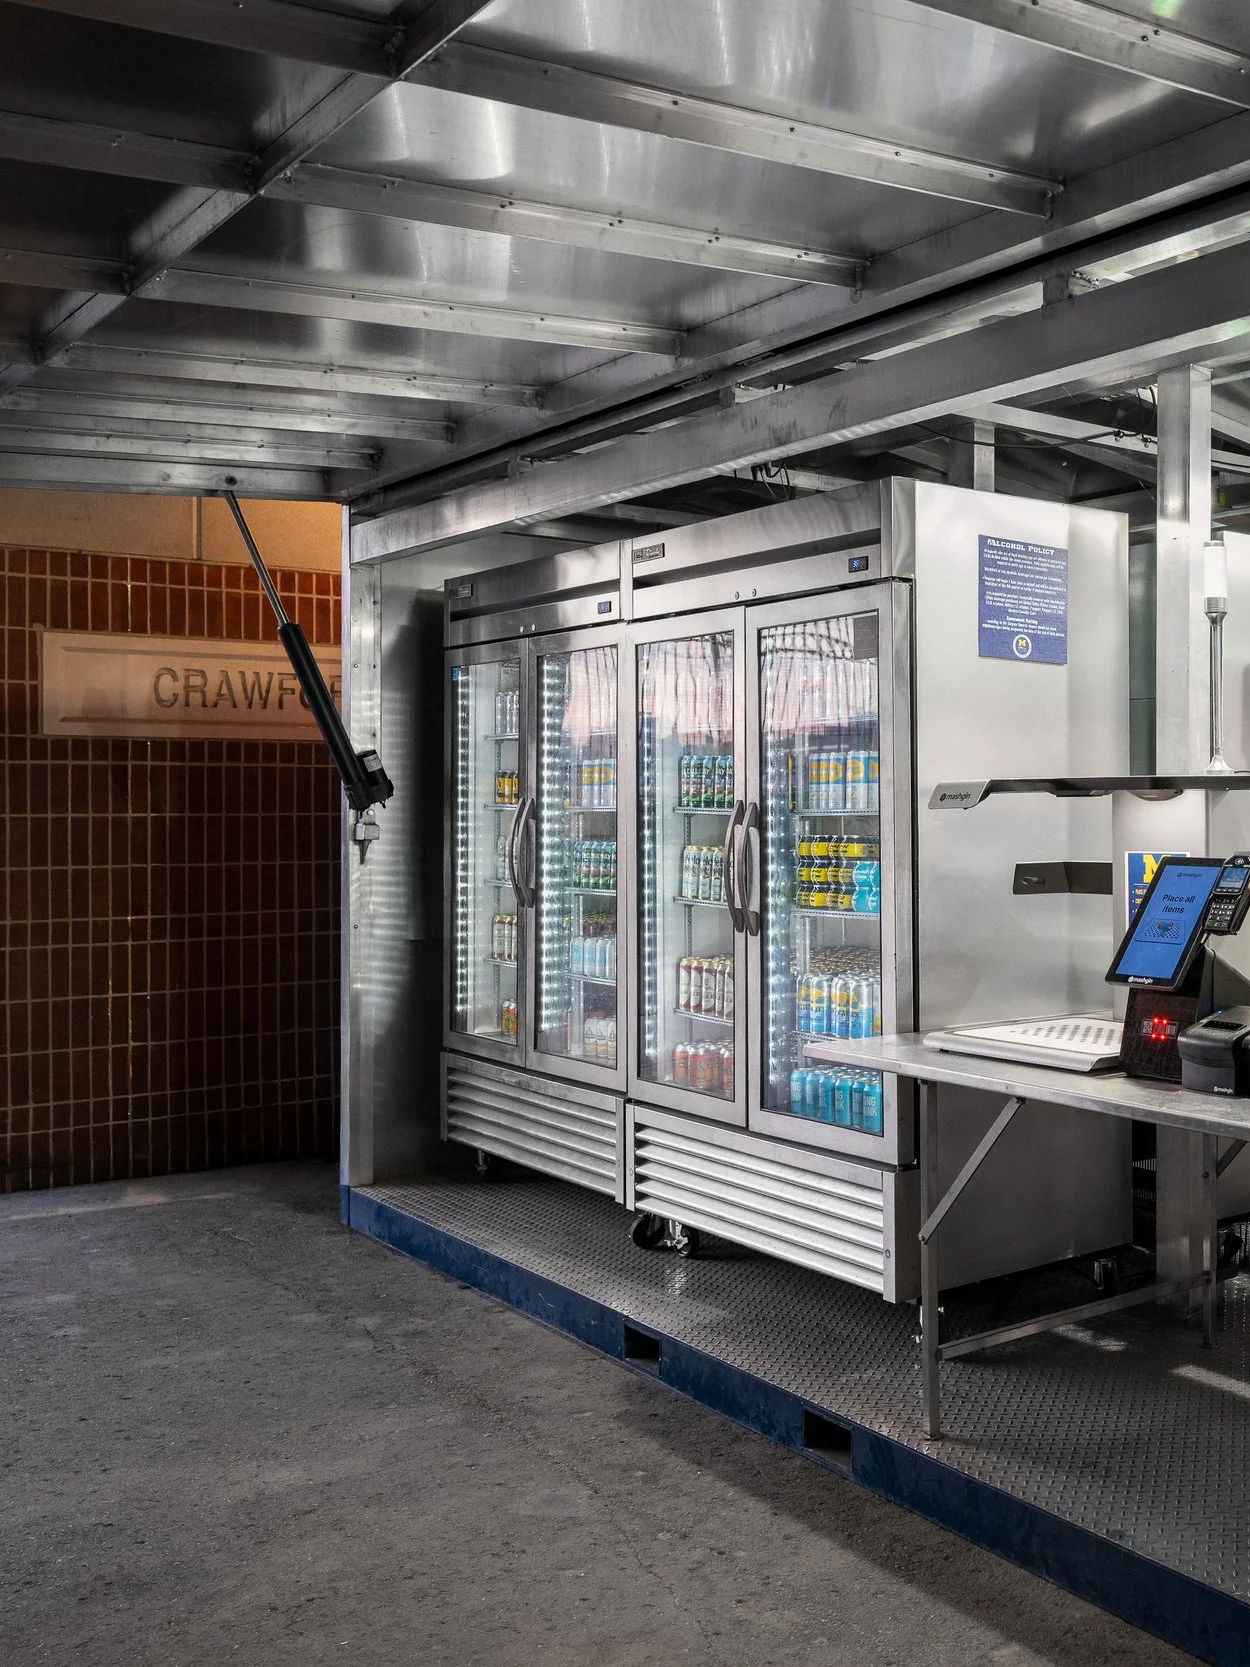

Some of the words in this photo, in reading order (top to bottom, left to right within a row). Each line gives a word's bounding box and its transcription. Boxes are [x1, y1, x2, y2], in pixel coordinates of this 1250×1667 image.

[987, 538, 1025, 551] ALCOHOL
[1028, 545, 1055, 555] POLICY
[153, 667, 342, 712] CRAWF
[945, 792, 971, 801] mashgin
[1162, 894, 1184, 903] Place
[1162, 905, 1185, 914] items
